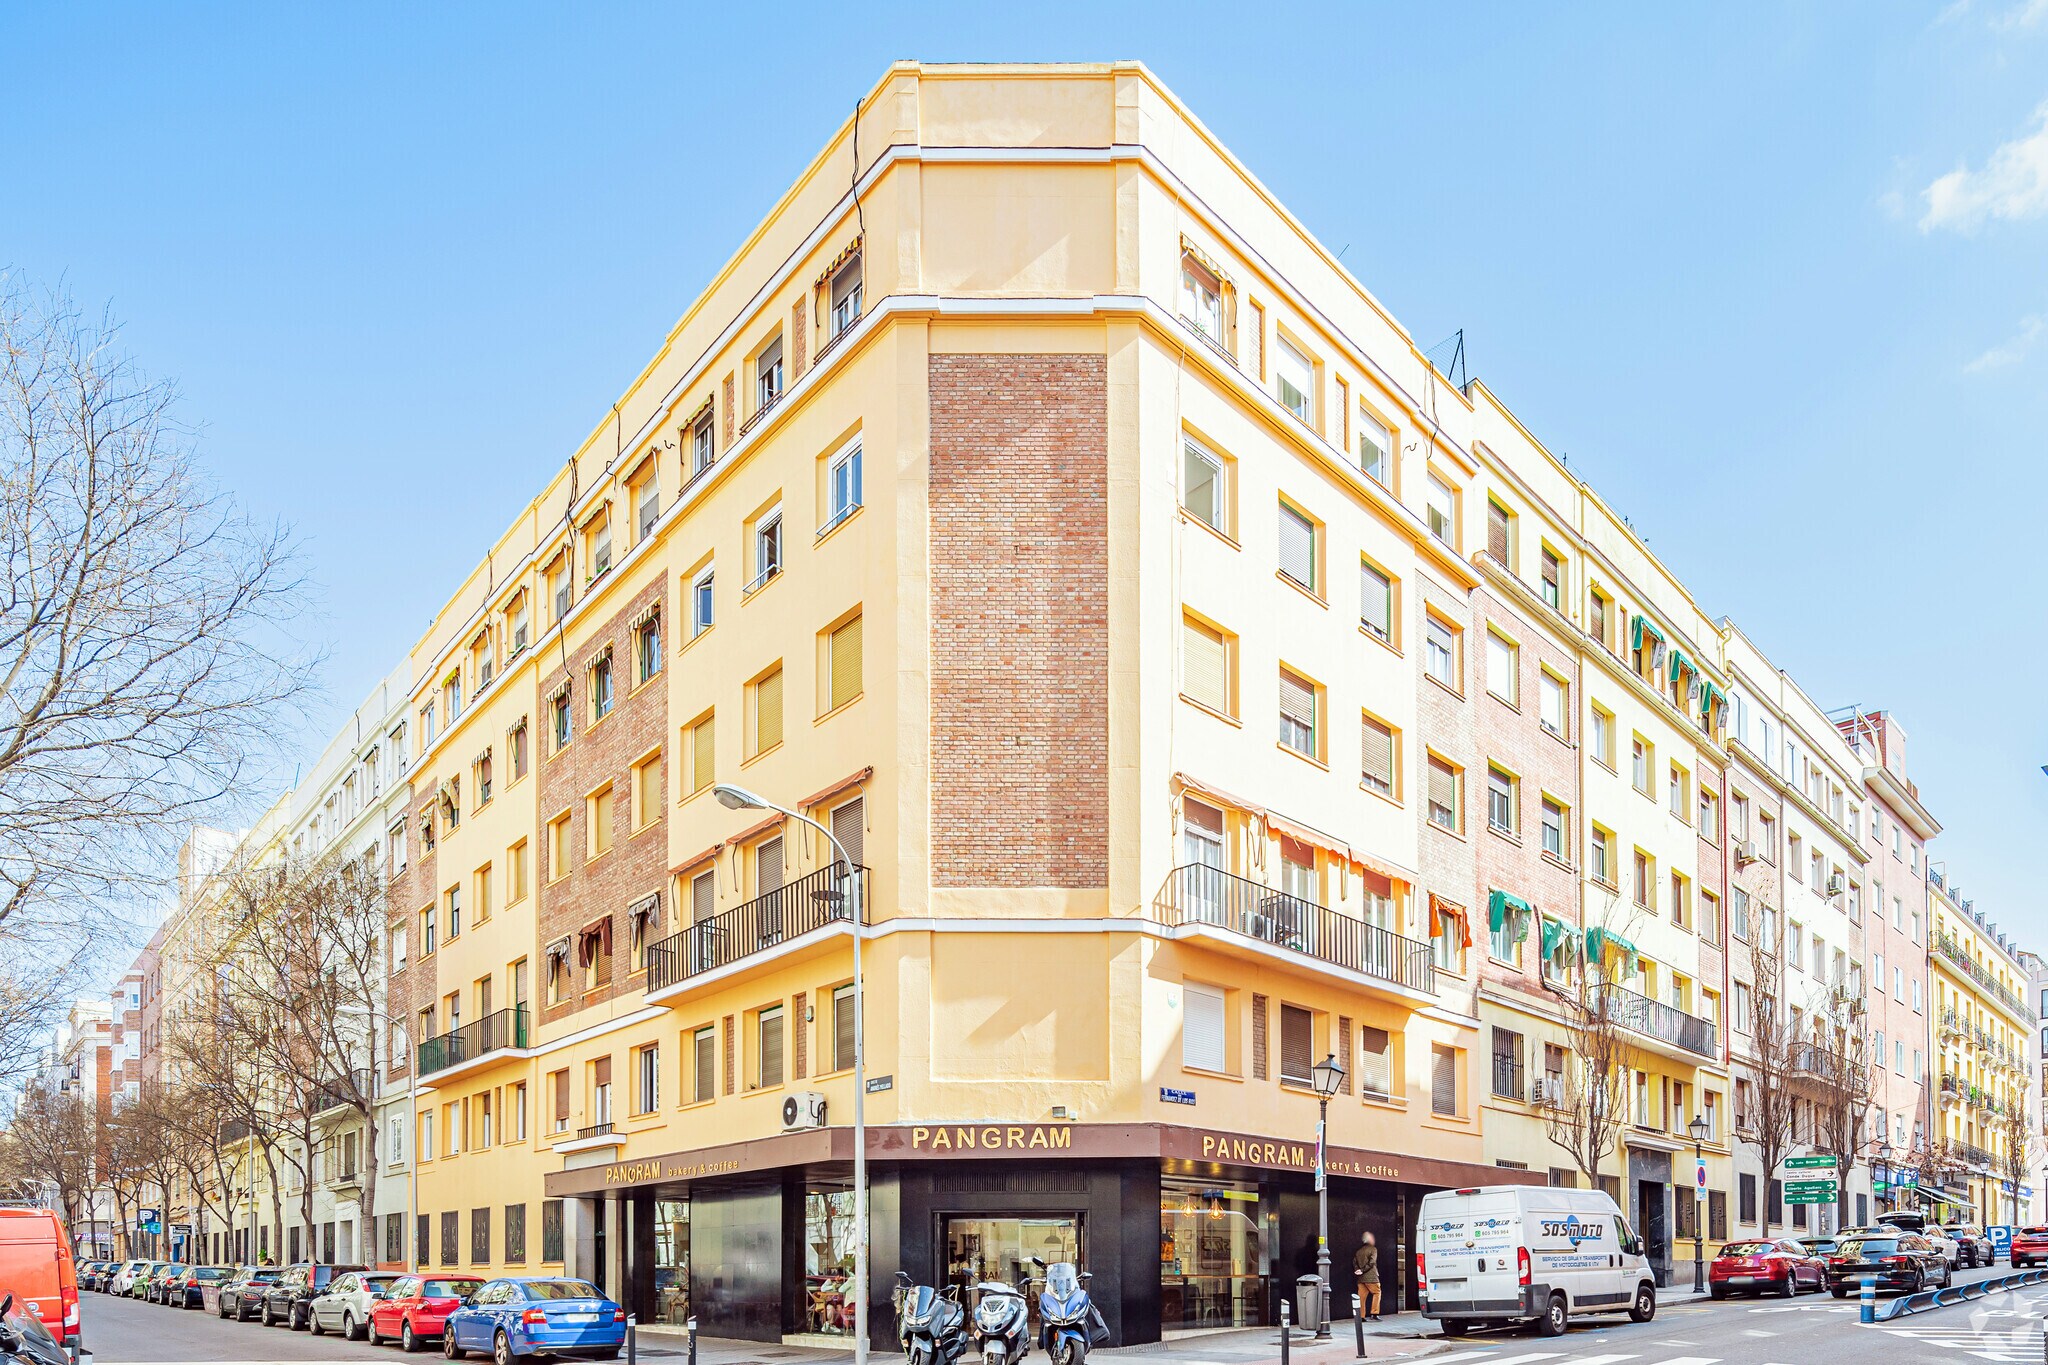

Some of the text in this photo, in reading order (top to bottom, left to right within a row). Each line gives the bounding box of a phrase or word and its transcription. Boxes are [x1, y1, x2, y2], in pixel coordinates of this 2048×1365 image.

[912, 1127, 1071, 1149] PANGRAM
[1202, 1135, 1399, 1177] PANGRAM bkery & coffee
[606, 1160, 738, 1184] PANGRAM bakery & coffee
[1542, 1223, 1603, 1237] SOSMOTO
